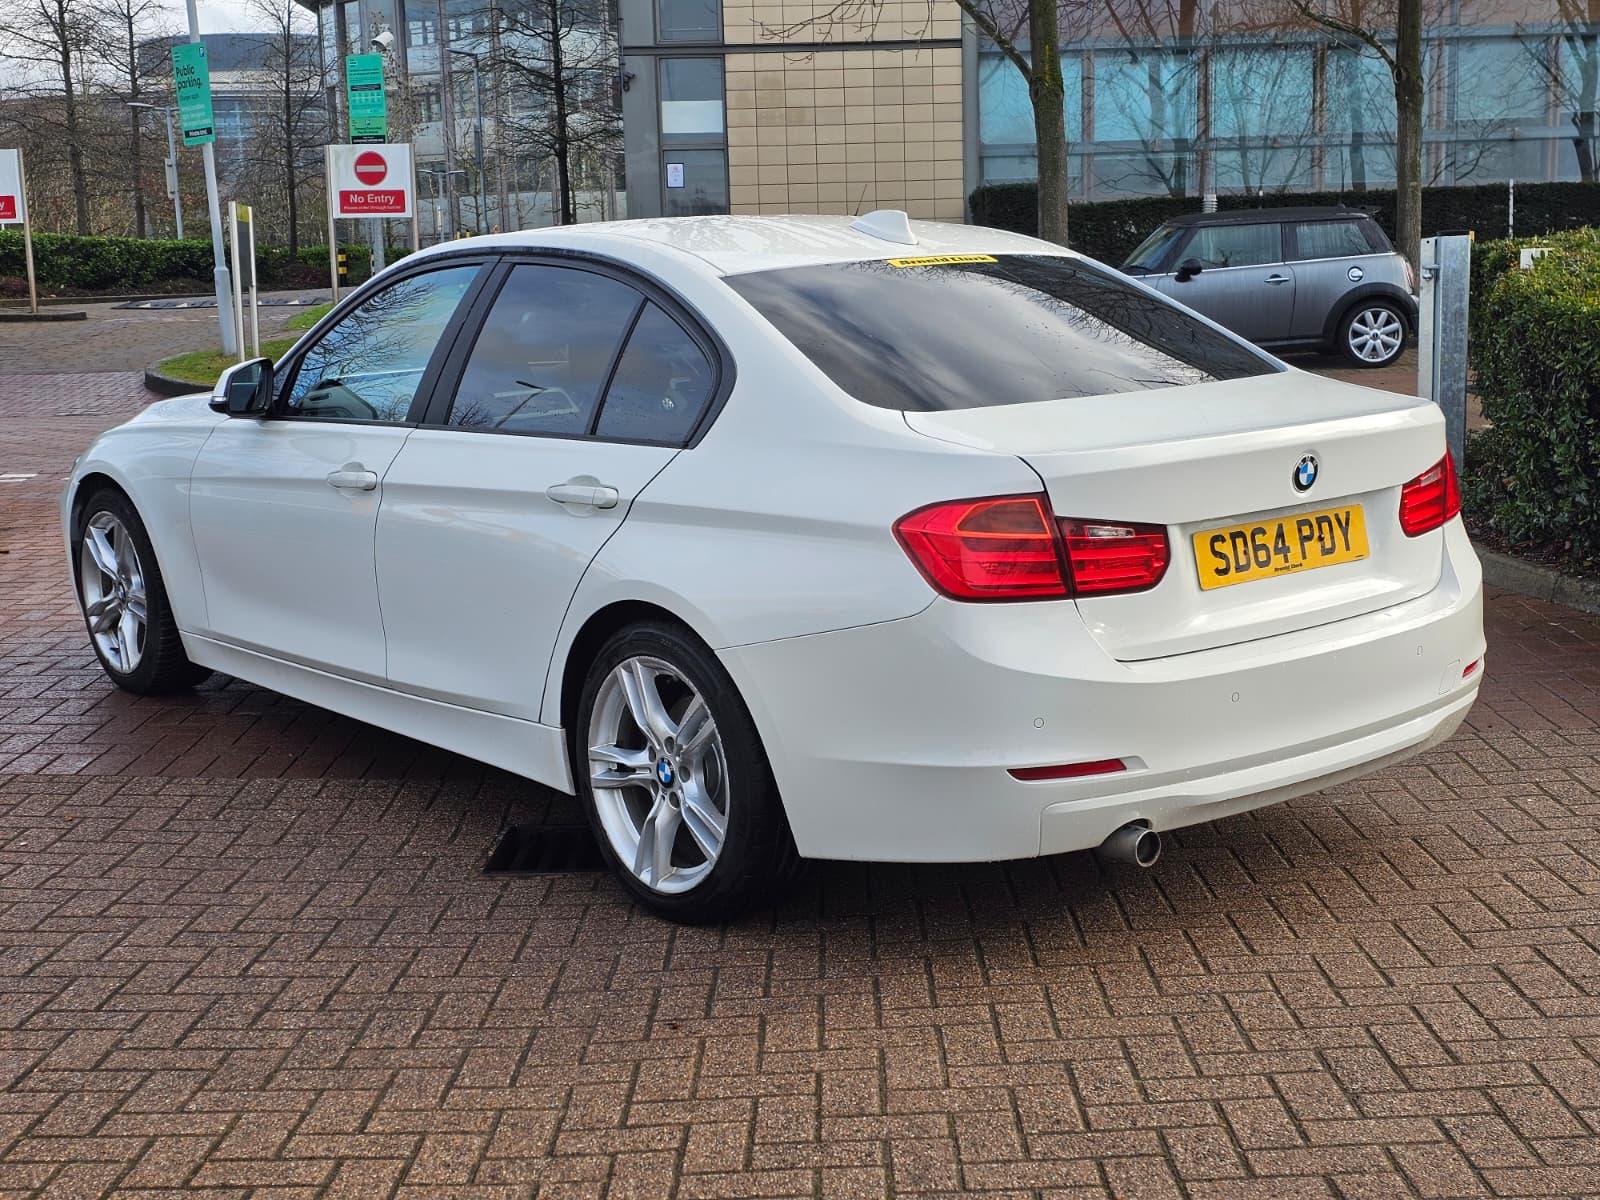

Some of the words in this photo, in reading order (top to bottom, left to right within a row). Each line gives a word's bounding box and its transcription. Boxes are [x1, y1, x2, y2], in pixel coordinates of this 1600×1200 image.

[175, 64, 195, 77] Public
[350, 194, 364, 203] No
[368, 194, 395, 205] Entry
[1209, 522, 1290, 577] SD64
[1296, 511, 1350, 560] PDY
